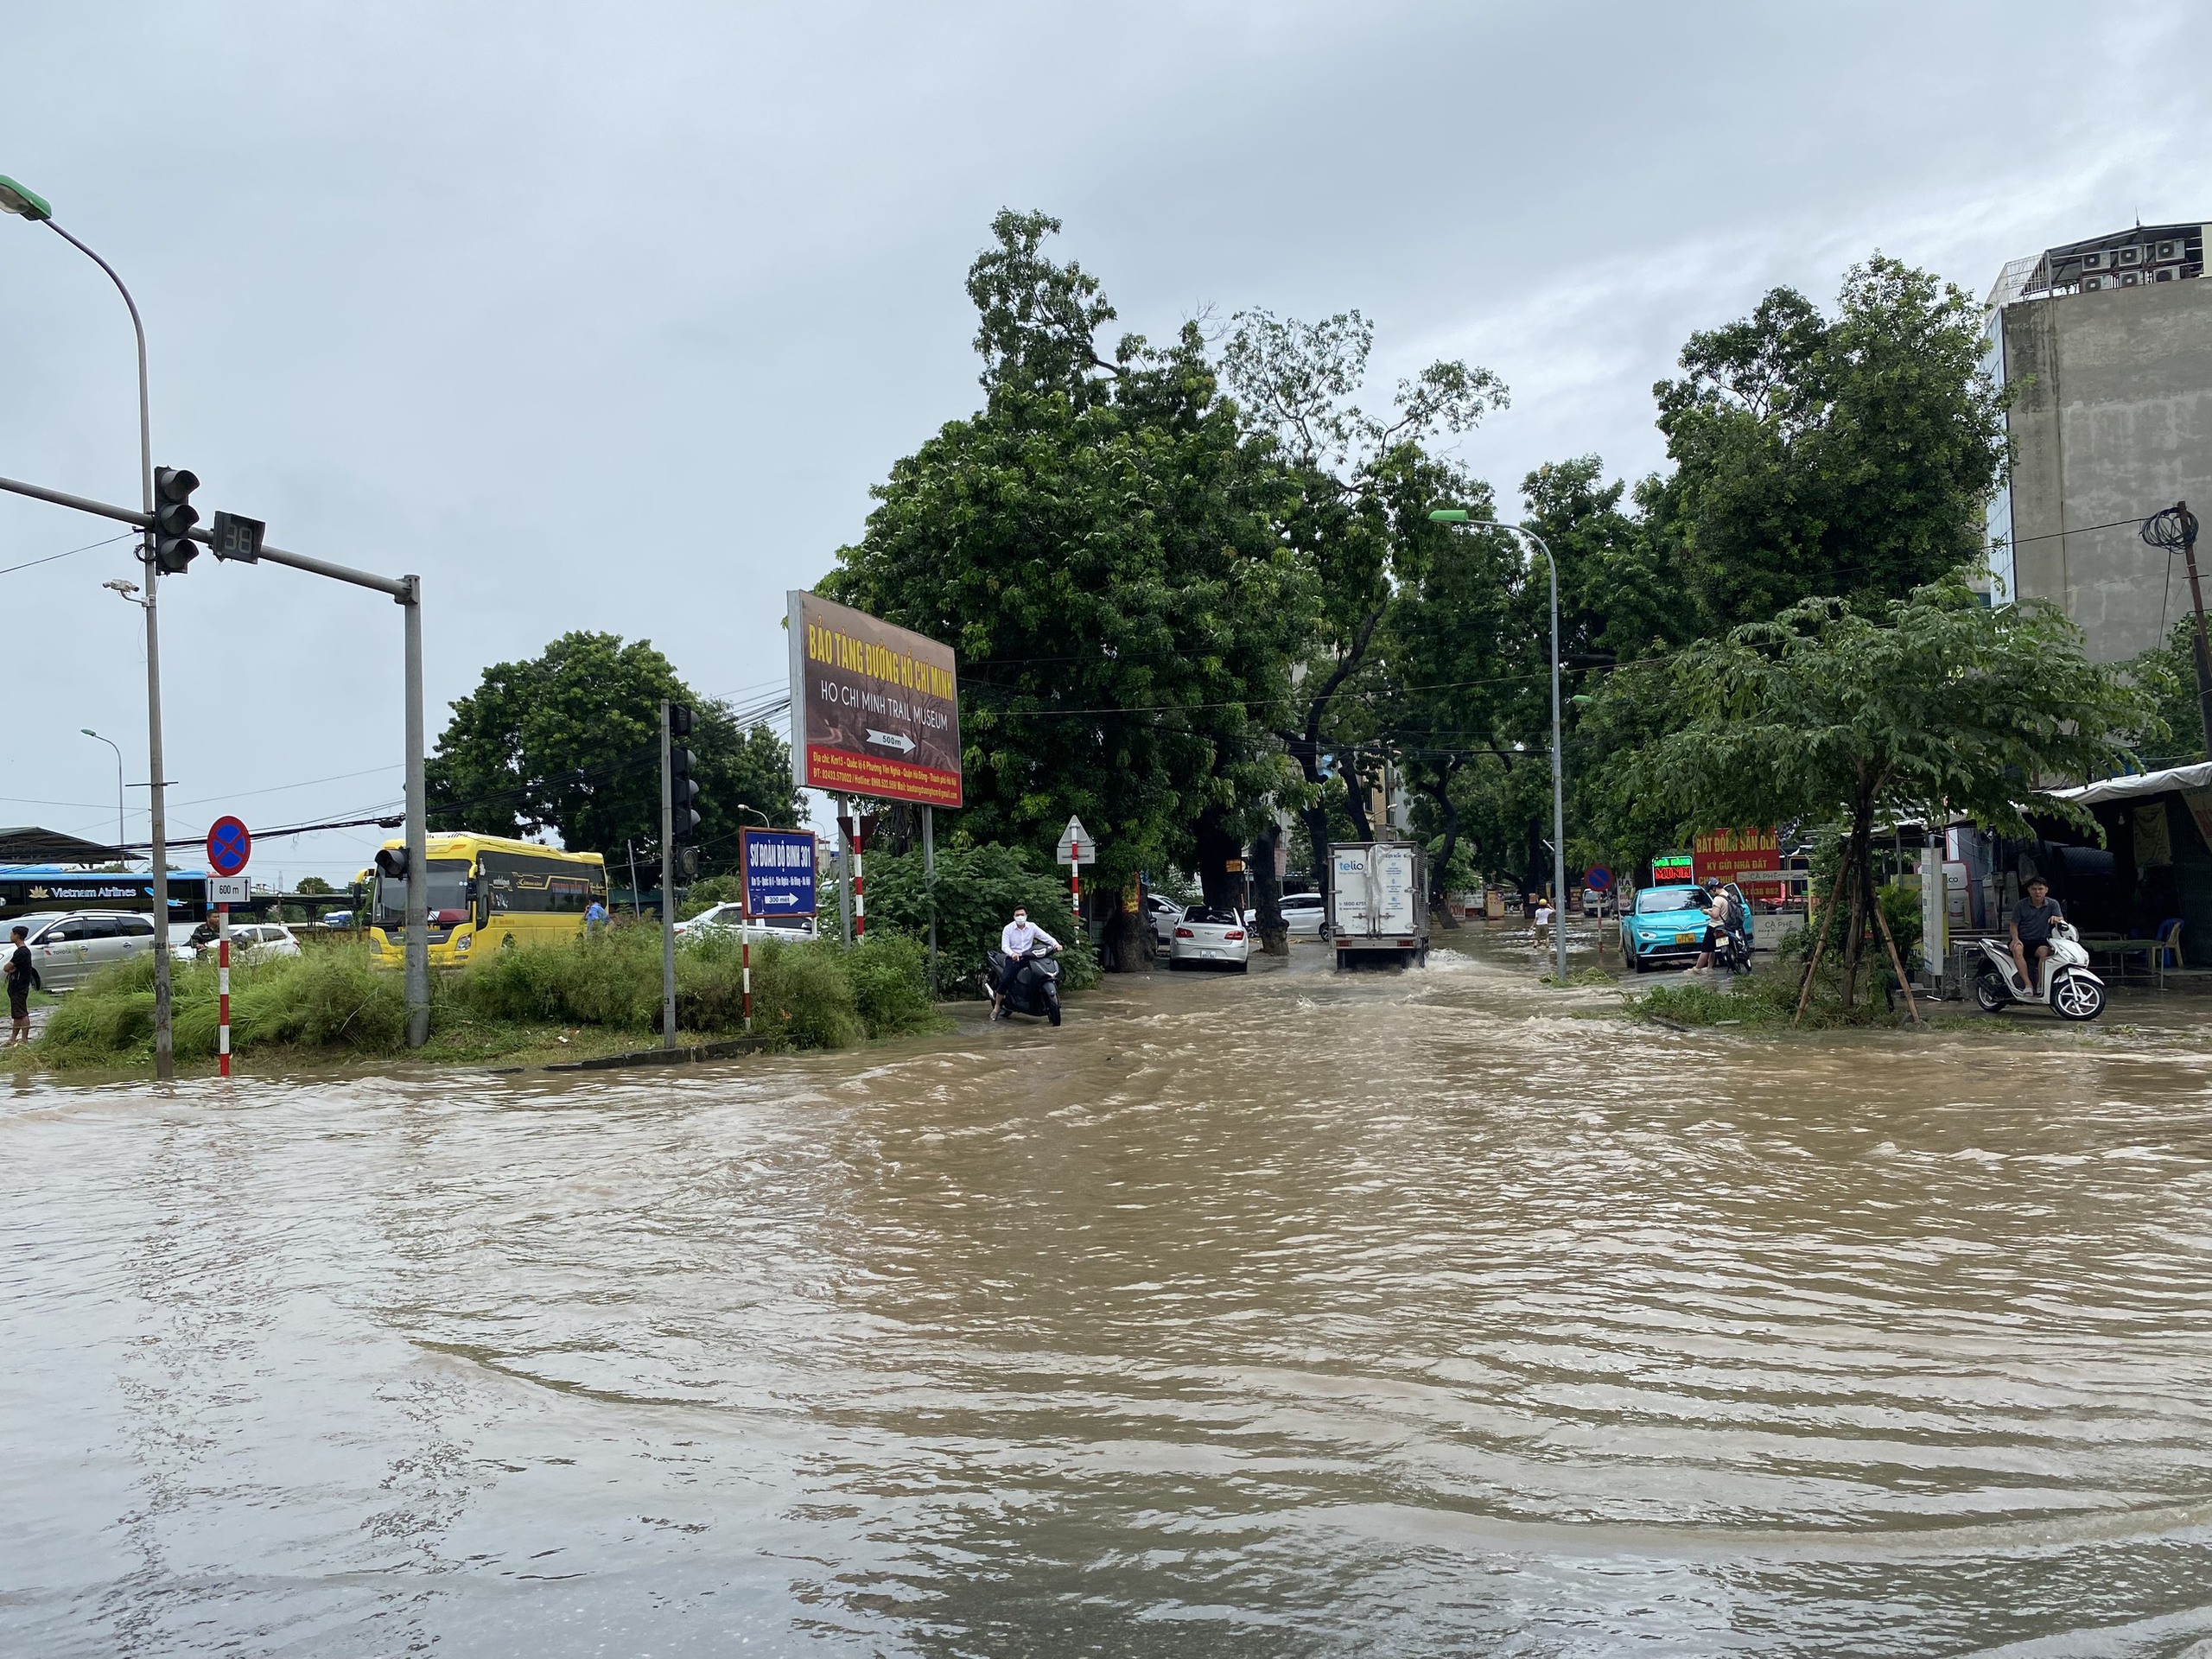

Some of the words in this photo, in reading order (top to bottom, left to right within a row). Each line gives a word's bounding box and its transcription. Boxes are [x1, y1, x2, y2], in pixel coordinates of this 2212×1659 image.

[809, 614, 833, 664] BẢO
[835, 627, 864, 674] TÀNG
[865, 639, 899, 685] ĐƯỜNG
[915, 657, 930, 694] CHÍ
[931, 664, 953, 702] MINH
[821, 680, 838, 702] HO
[842, 685, 860, 709] CHI
[861, 691, 887, 715] MINH
[887, 698, 912, 722] TRAIL
[913, 705, 949, 732] MUSEUM
[882, 735, 902, 747] 500m
[801, 846, 810, 867] 301
[1339, 861, 1364, 871] telio
[1655, 867, 1692, 880] MINH
[51, 887, 96, 898] Vietnam
[98, 887, 137, 897] Airlines
[219, 885, 232, 894] 600
[1764, 920, 1777, 929] CÀ
